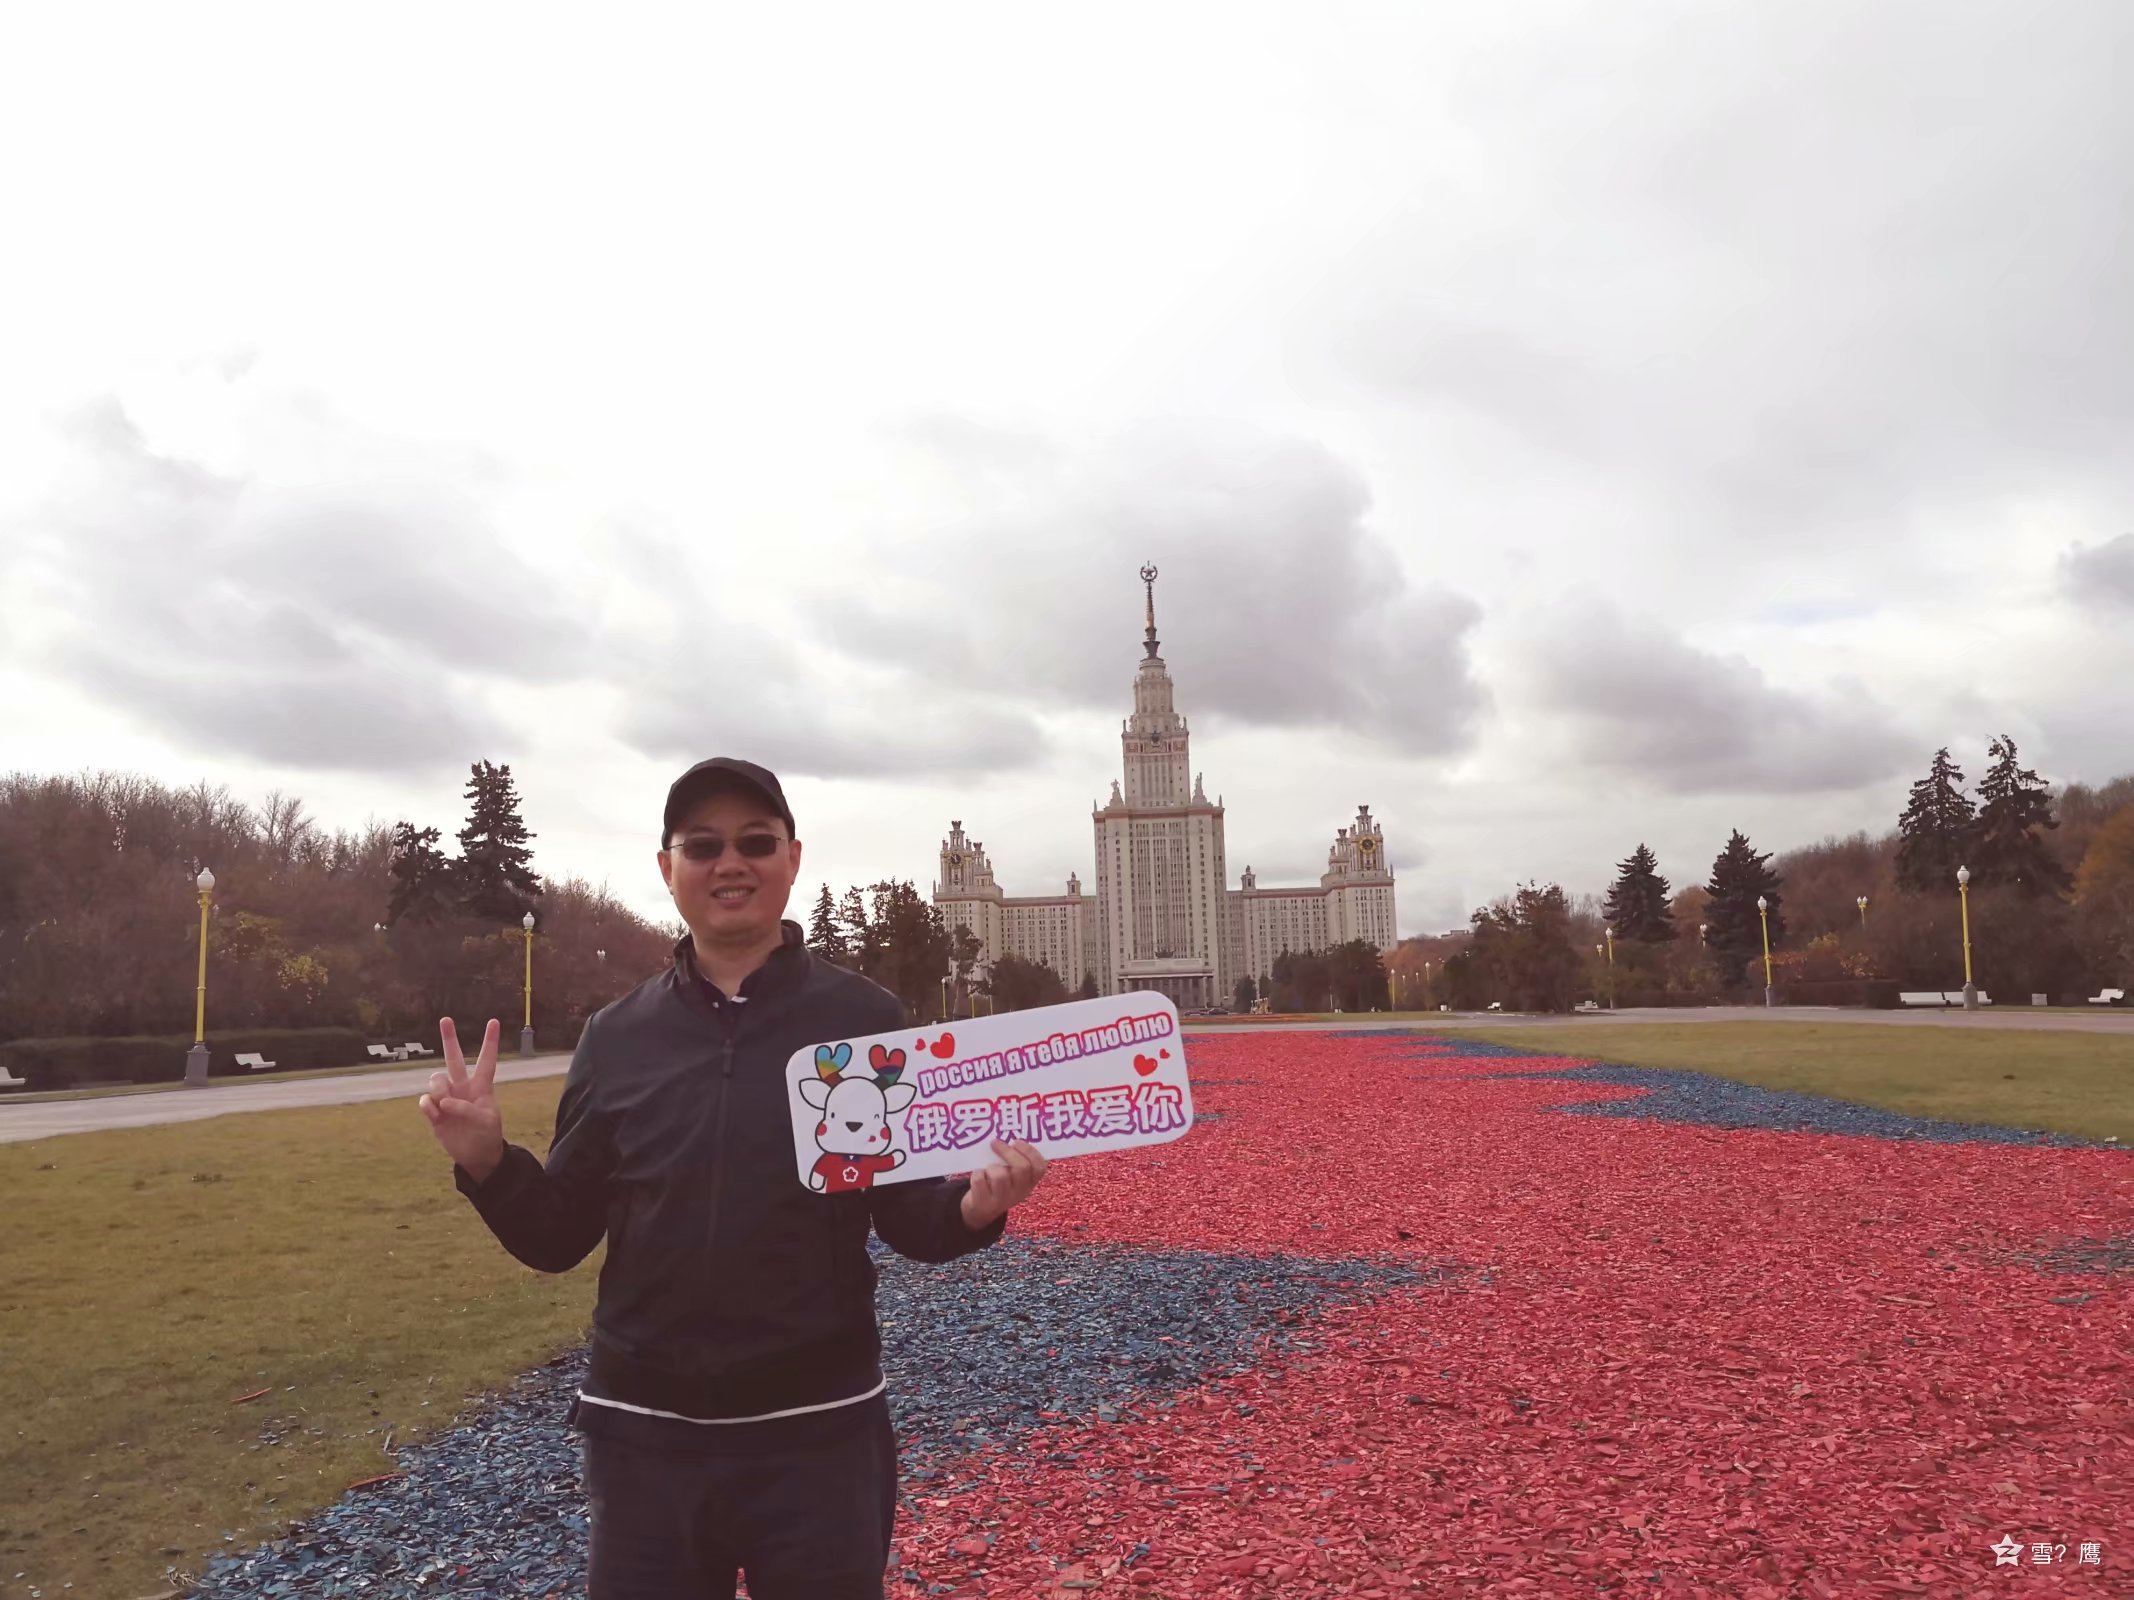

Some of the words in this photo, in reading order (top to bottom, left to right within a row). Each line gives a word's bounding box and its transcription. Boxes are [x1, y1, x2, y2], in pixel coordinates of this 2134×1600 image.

[918, 1052, 1005, 1097] россия
[1007, 1047, 1023, 1073] я
[1023, 1032, 1081, 1068] тебя
[1081, 1012, 1173, 1053] люблю
[906, 1082, 1187, 1152] 俄罗斯我爱你
